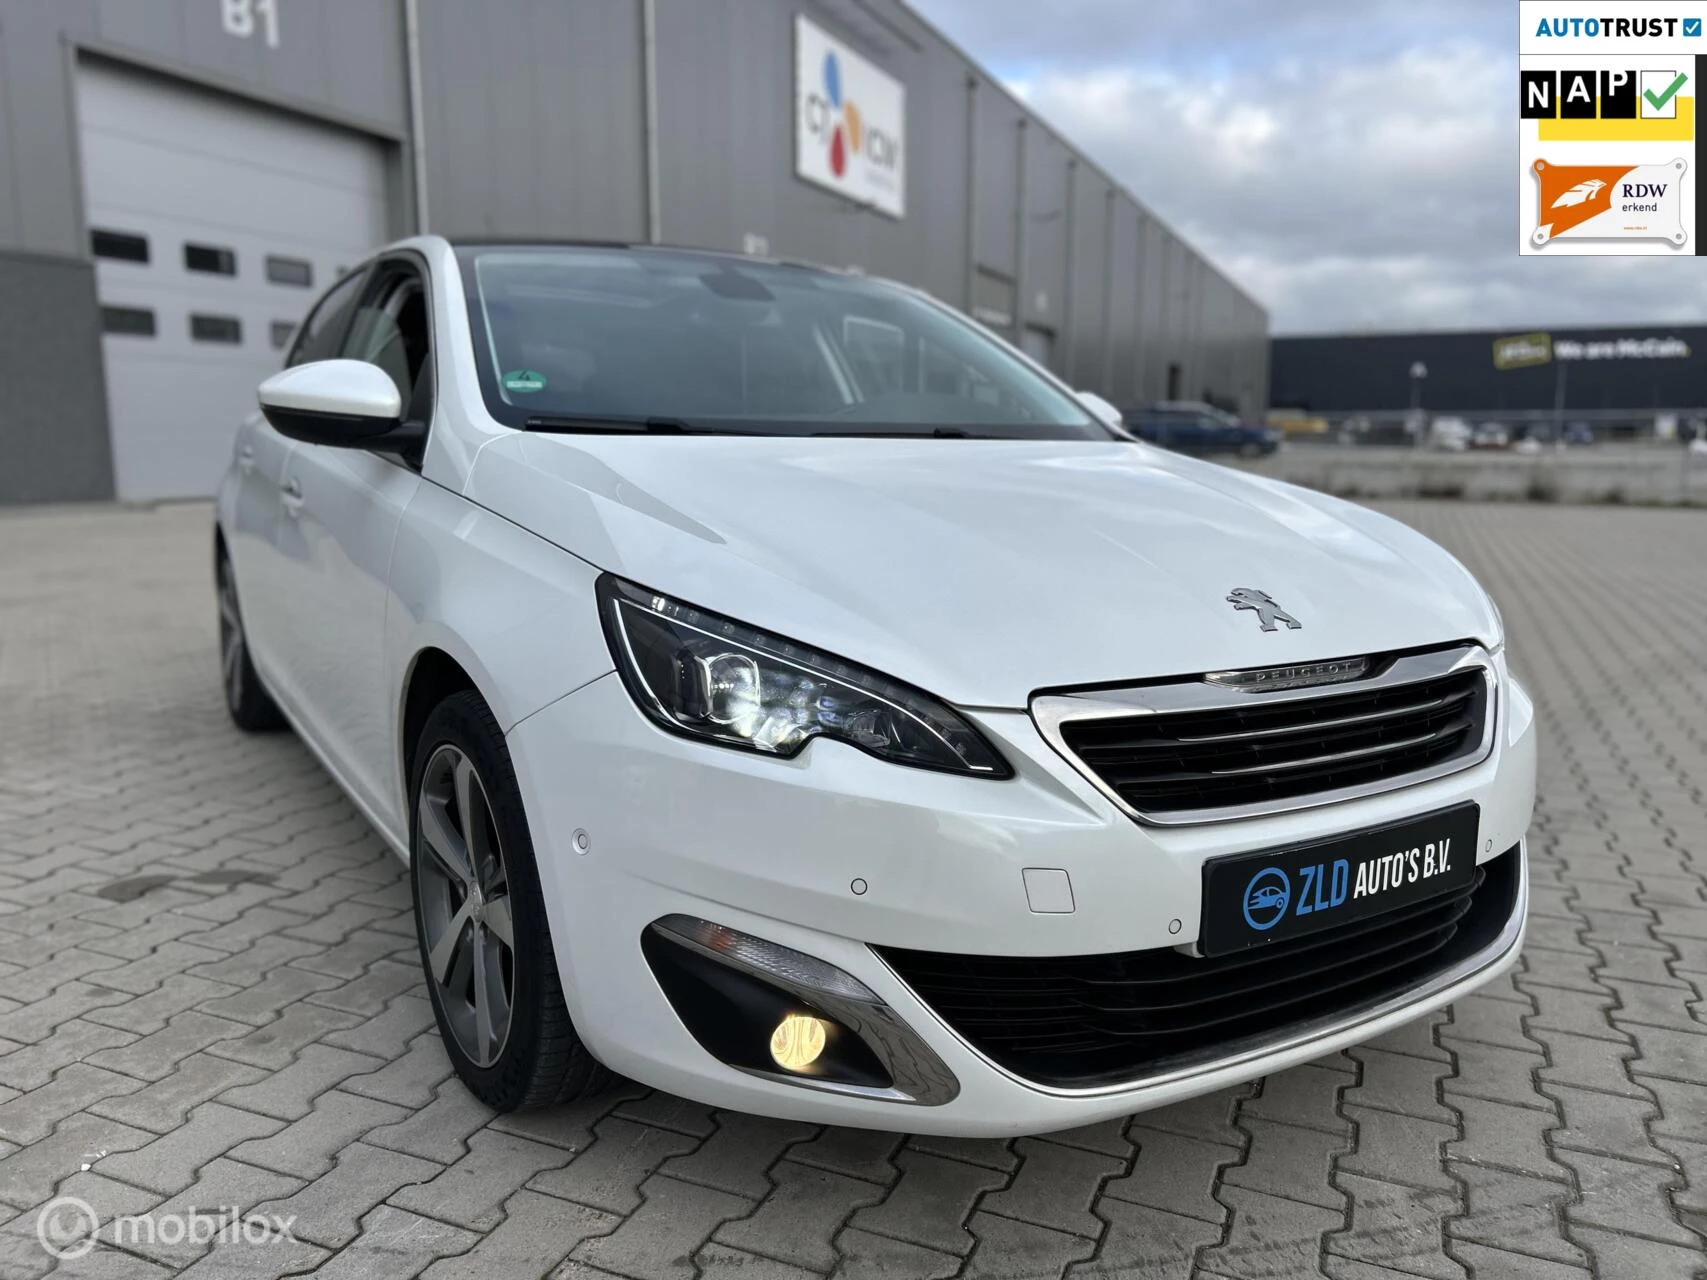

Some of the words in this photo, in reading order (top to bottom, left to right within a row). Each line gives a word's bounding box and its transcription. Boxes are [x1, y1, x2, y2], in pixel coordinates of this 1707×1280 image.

[1256, 662, 1351, 683] PEUGEOT
[1296, 858, 1349, 916] ZLD
[1353, 848, 1419, 899] AUTO'S
[1423, 838, 1451, 879] B.V.
